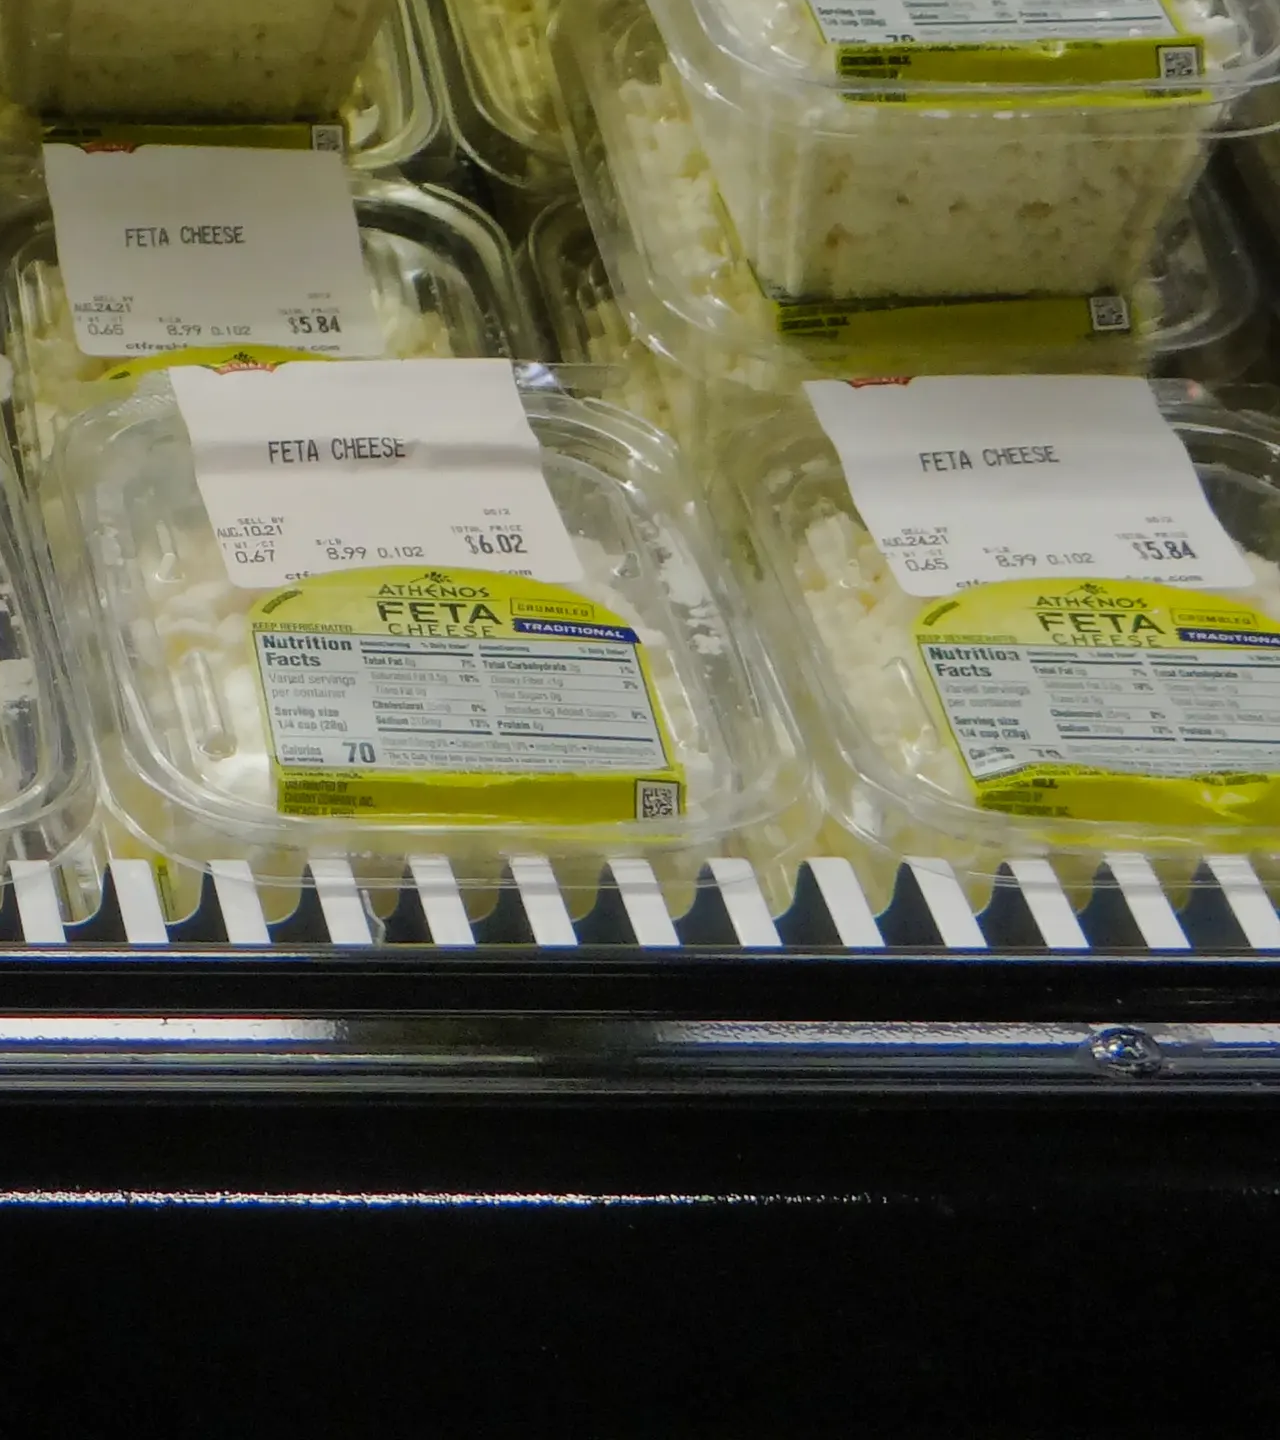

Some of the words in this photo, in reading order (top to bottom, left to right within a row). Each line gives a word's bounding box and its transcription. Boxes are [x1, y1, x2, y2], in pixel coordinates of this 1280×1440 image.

[124, 228, 169, 248] FETA
[179, 226, 246, 245] CHEESE
[287, 316, 341, 334] $5.84
[268, 441, 319, 464] FETA
[330, 437, 406, 461] CHEESE
[919, 452, 972, 473] FETA
[982, 445, 1060, 469] CHEESE
[464, 533, 528, 555] $6.02
[1132, 541, 1197, 560] $5.84
[377, 584, 490, 599] ATHENOS
[377, 601, 503, 626] FETA
[1036, 612, 1166, 635] FETA
[522, 621, 625, 639] TRADITIONAL
[262, 635, 352, 653] Nutrition
[265, 652, 322, 669] Facts
[342, 741, 377, 764] 70
